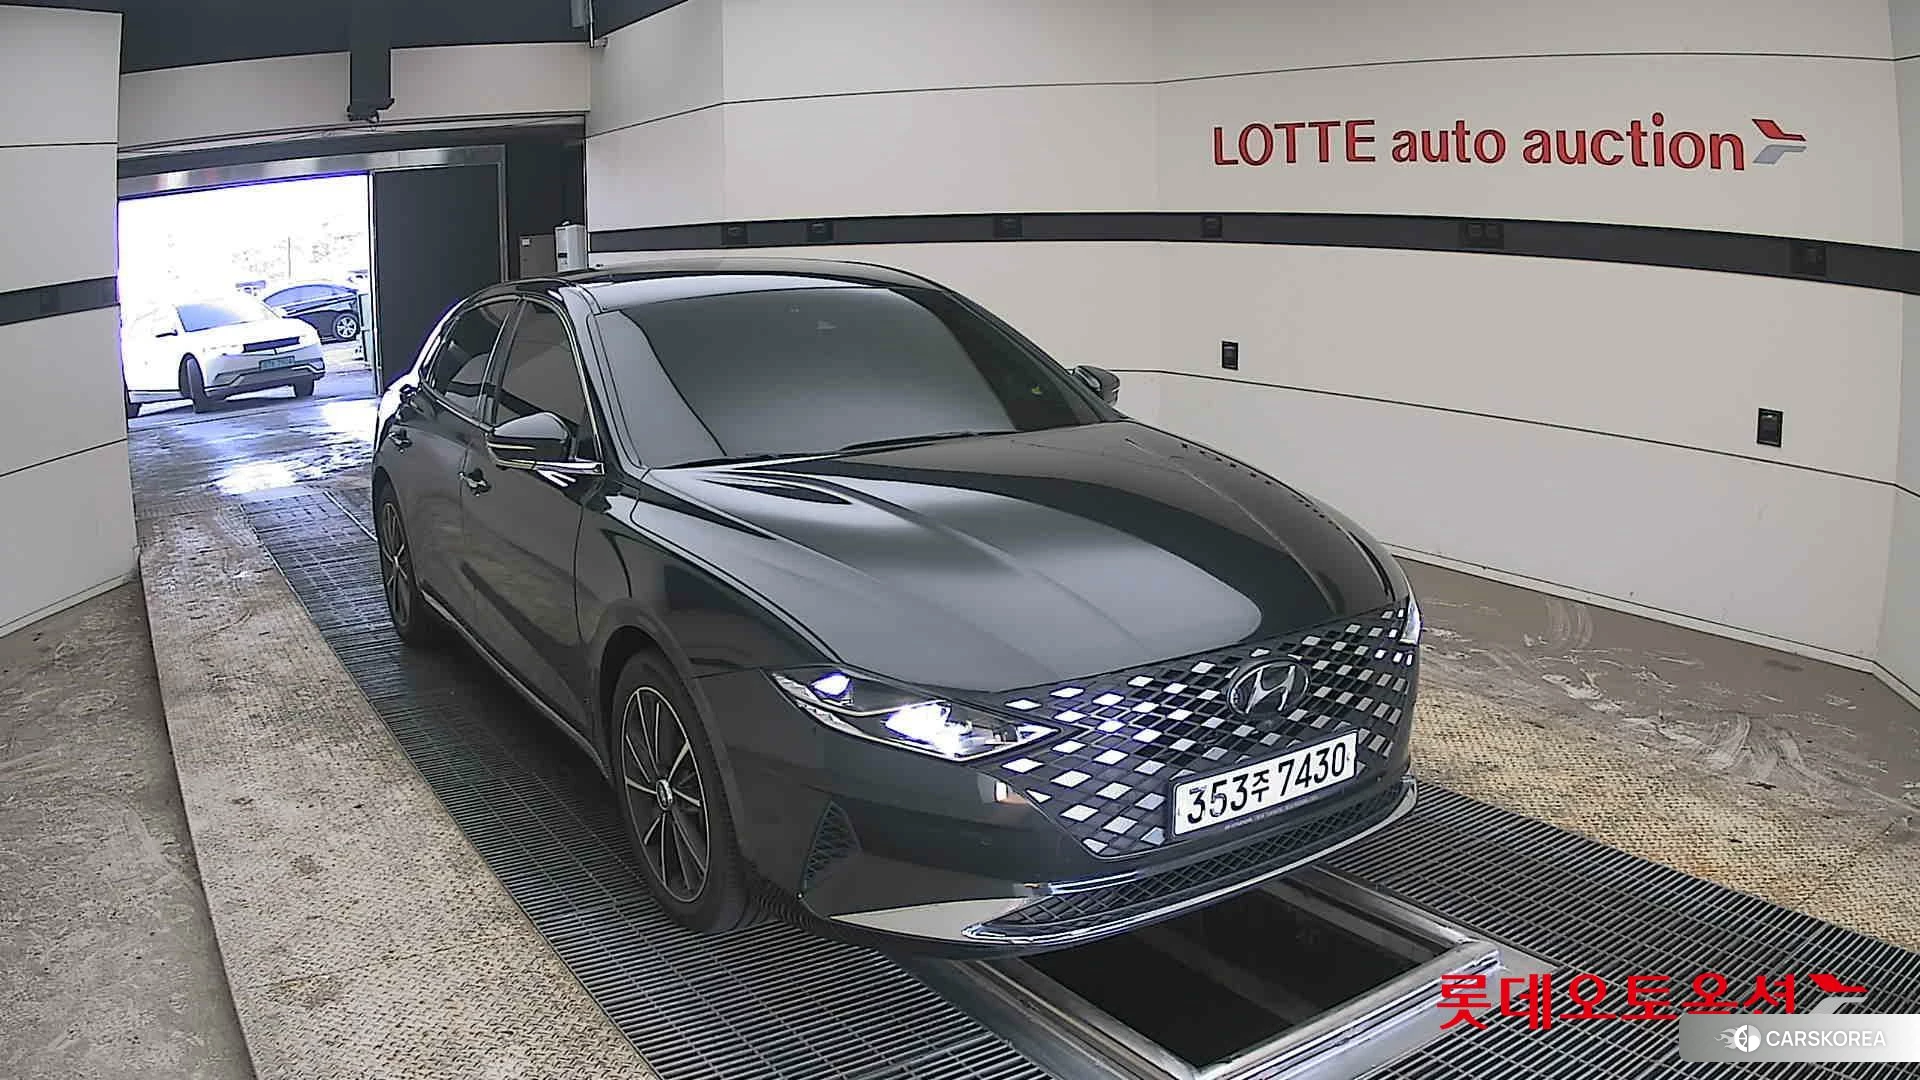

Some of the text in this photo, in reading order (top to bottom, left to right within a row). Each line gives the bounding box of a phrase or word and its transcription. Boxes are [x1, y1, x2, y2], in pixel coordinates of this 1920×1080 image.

[1213, 111, 1746, 171] LOTTE auto auction
[1187, 769, 1270, 824] 353주
[1278, 742, 1347, 797] 7430
